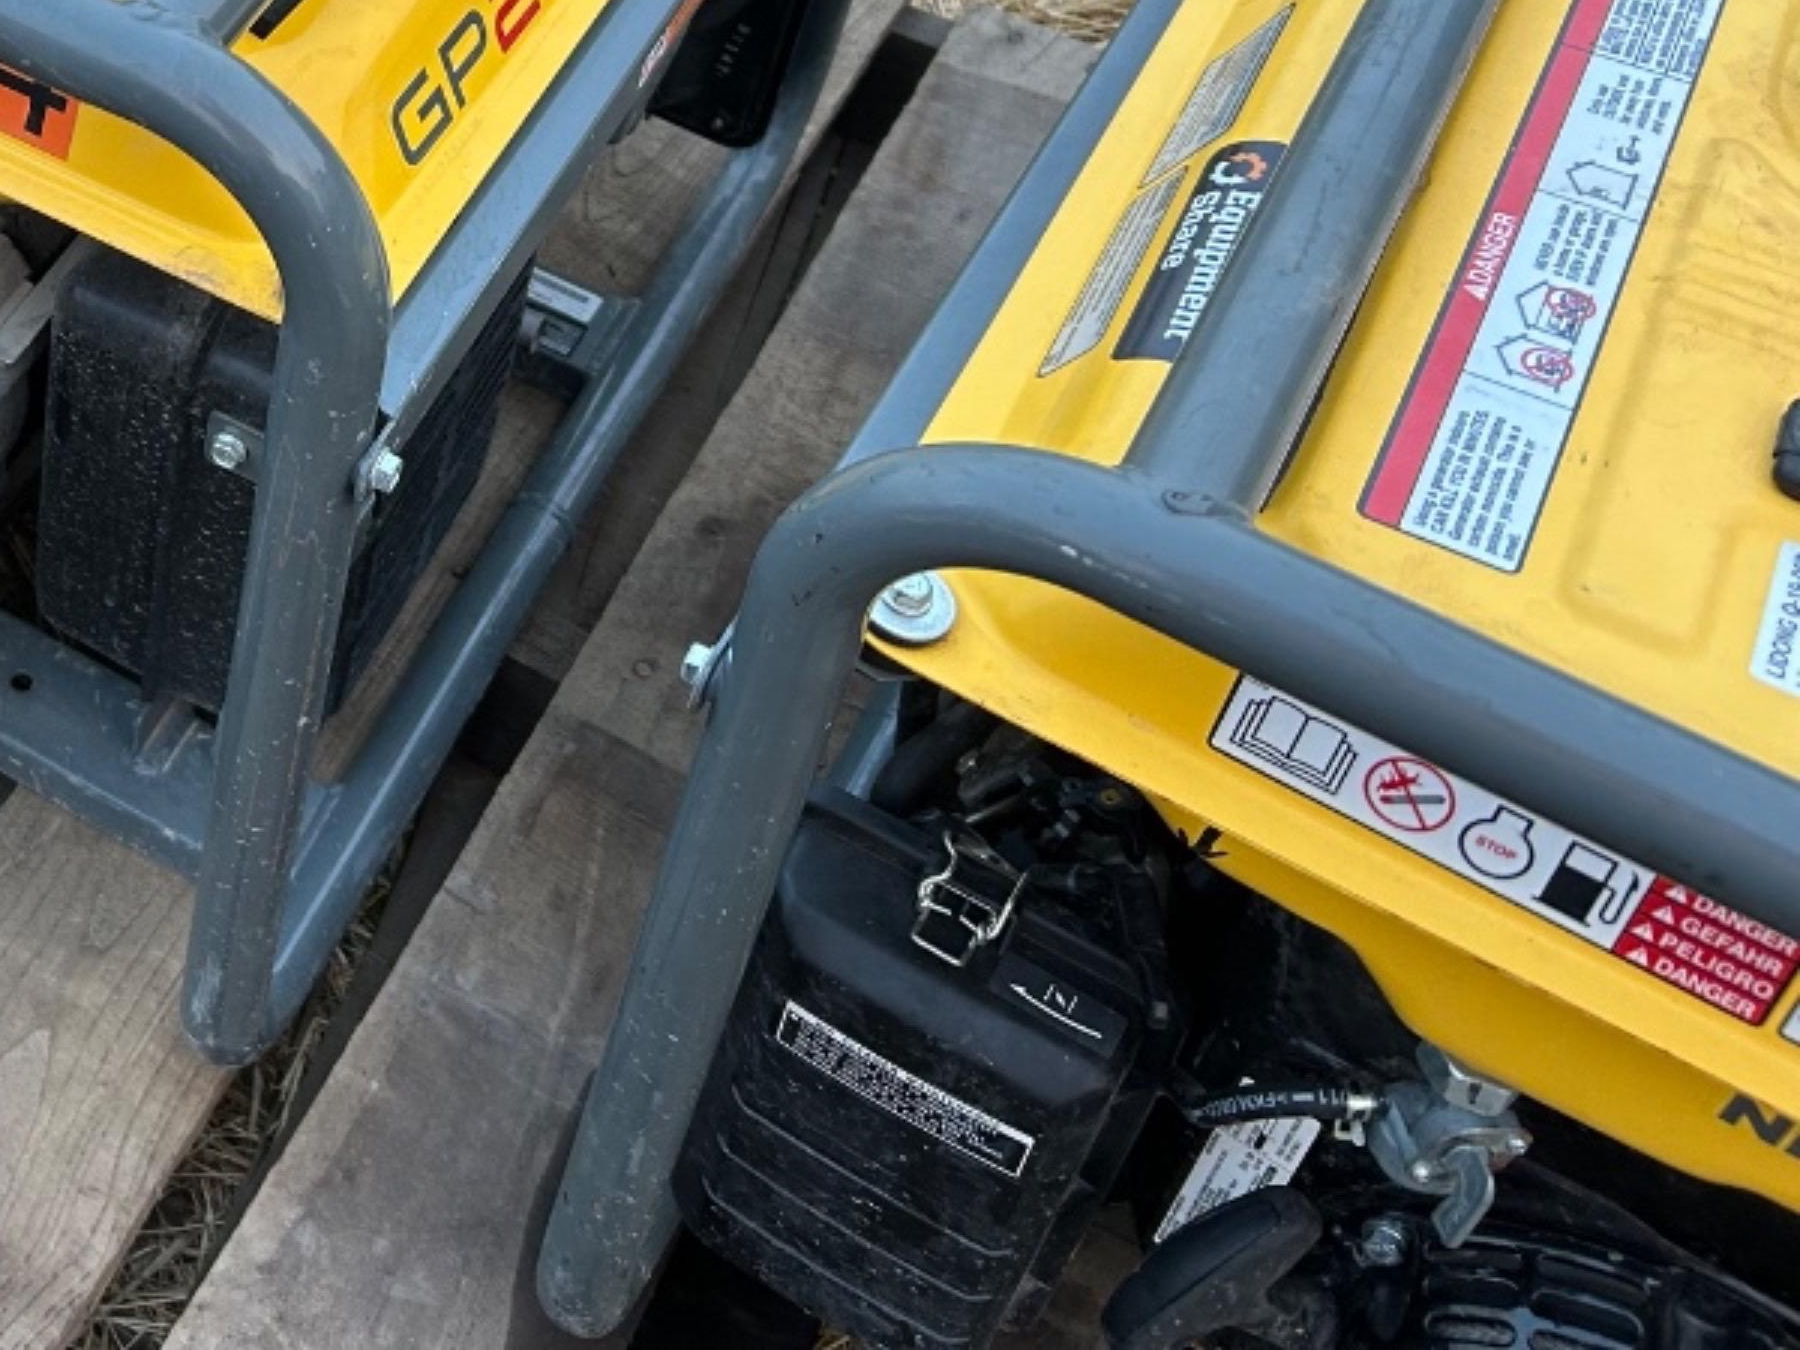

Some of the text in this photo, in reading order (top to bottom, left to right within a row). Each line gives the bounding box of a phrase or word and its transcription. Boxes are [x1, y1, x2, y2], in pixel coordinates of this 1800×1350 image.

[1160, 190, 1222, 271] Share
[1475, 209, 1517, 288] DANGER
[1163, 189, 1264, 340] Equipment
[1475, 834, 1518, 861] STOP
[1680, 917, 1784, 976] GEFAHR
[1691, 895, 1800, 957] DANGER
[1653, 957, 1758, 1019] DANGER
[1657, 931, 1776, 1000] PELIGRO
